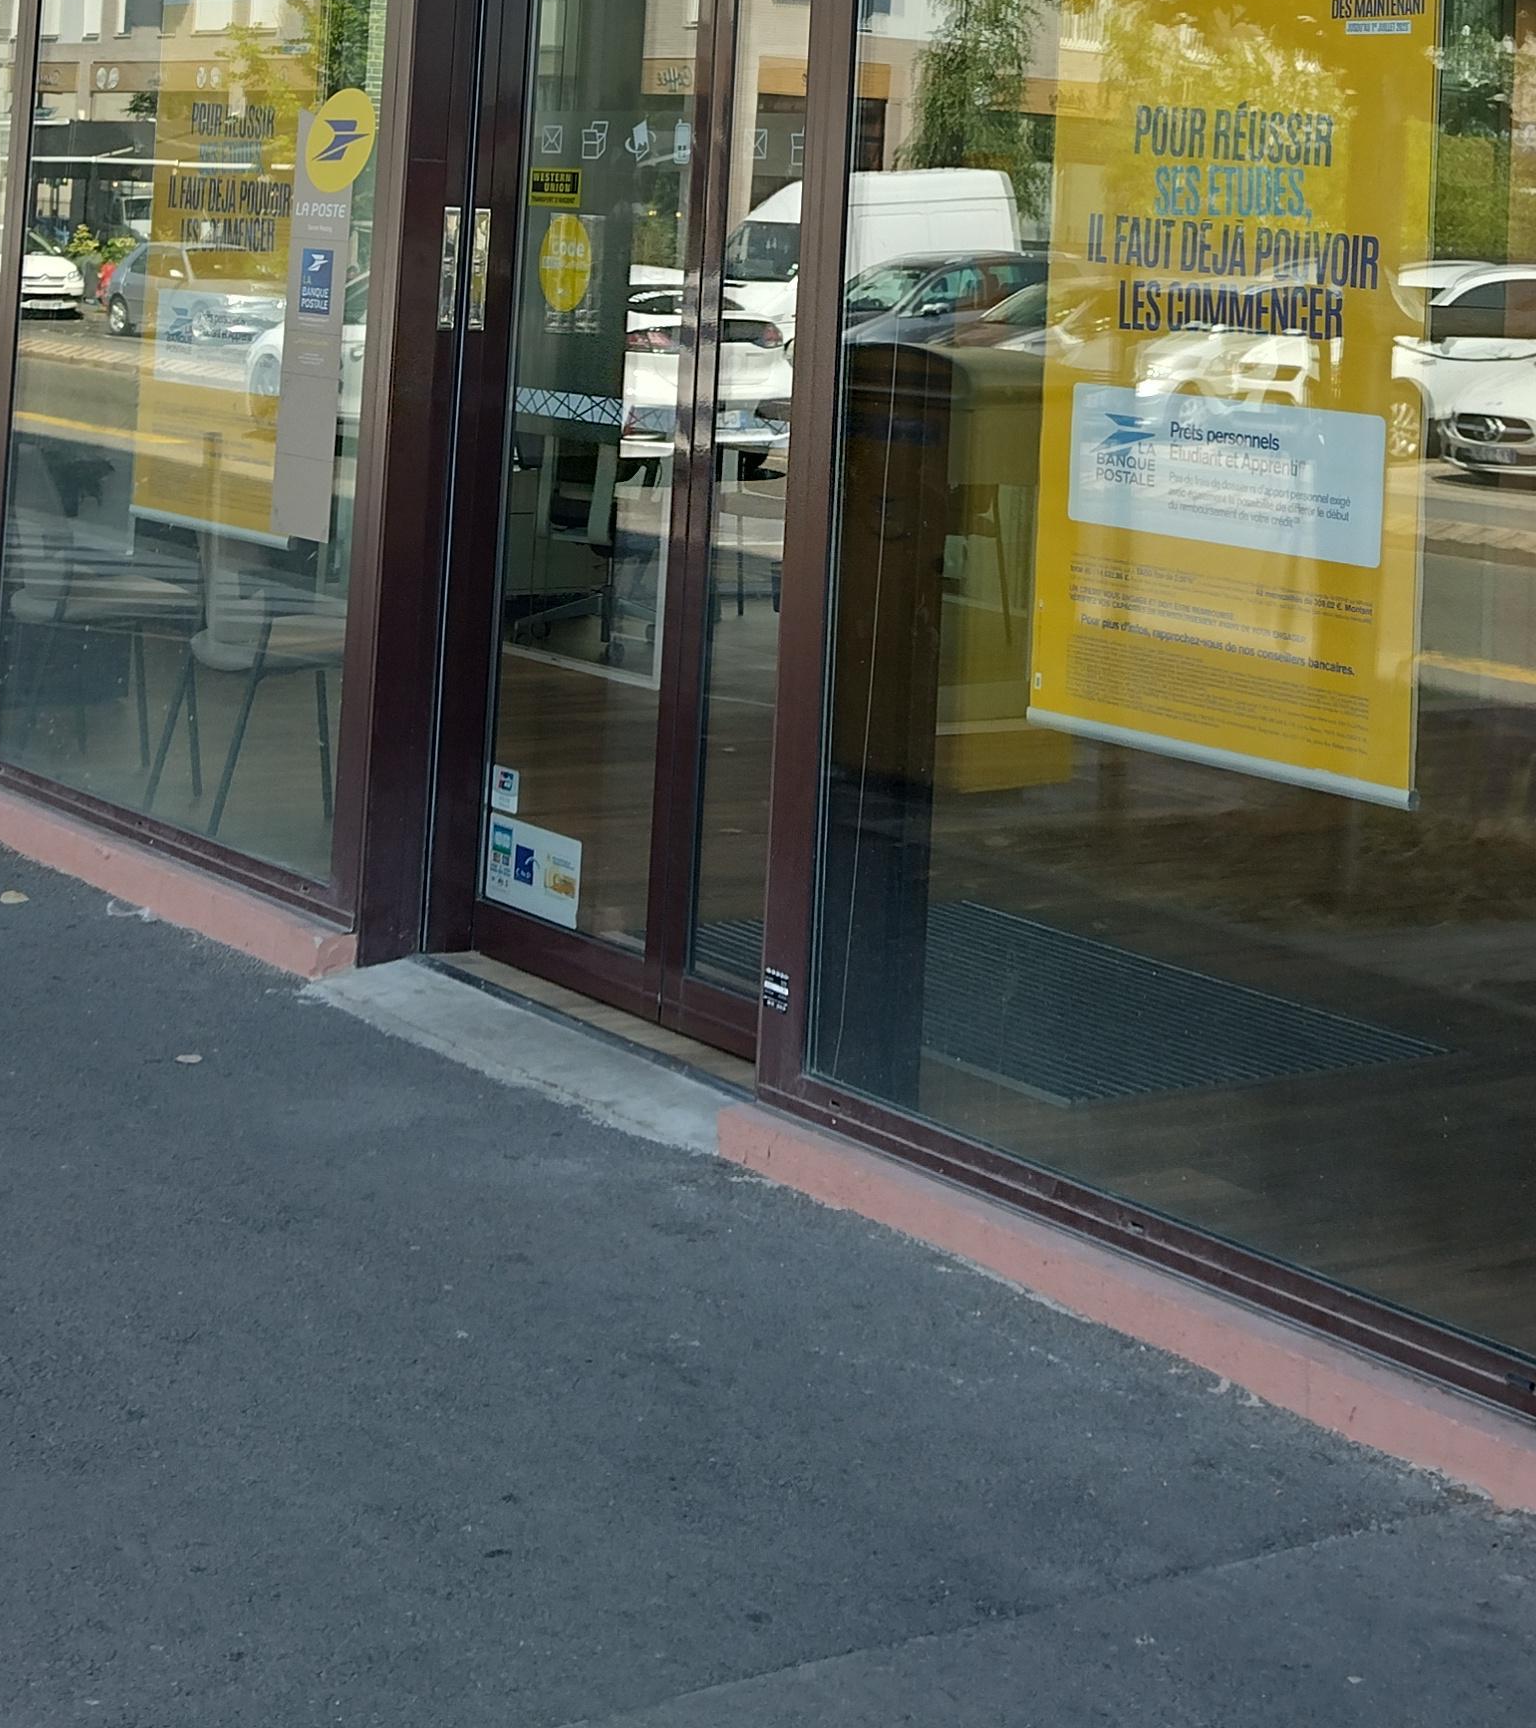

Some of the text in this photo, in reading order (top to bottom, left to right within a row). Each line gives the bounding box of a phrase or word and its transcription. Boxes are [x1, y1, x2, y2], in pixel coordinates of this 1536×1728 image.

[191, 102, 221, 136] POUR
[1134, 100, 1334, 167] POUR RÉUSSIR
[533, 172, 571, 182] WESTERN
[544, 182, 571, 192] UNION
[168, 176, 177, 208] IL
[180, 176, 205, 210] FAUT
[240, 181, 292, 217] POUVOIR
[1154, 165, 1201, 216] SES
[295, 203, 346, 218] LA POSTE
[181, 219, 275, 253] LES OMMENCER
[1087, 213, 1379, 290] IL FAUT DÉJÀ POUVOIR
[302, 286, 329, 298] BANQUE
[303, 275, 312, 285] LA
[300, 298, 329, 310] POSTALE
[1119, 280, 1343, 340] LES COMMENCER
[1170, 421, 1280, 451] Prêts personnels
[1138, 441, 1156, 457] LA
[1169, 439, 1222, 467] Étudiant
[1225, 452, 1239, 469] et
[1096, 452, 1156, 472] BANQUE
[1096, 467, 1156, 488] POSTALE
[1317, 506, 1324, 517] le
[1224, 642, 1237, 653] de
[1238, 644, 1255, 657] nos
[1308, 656, 1355, 676] bancaires.
